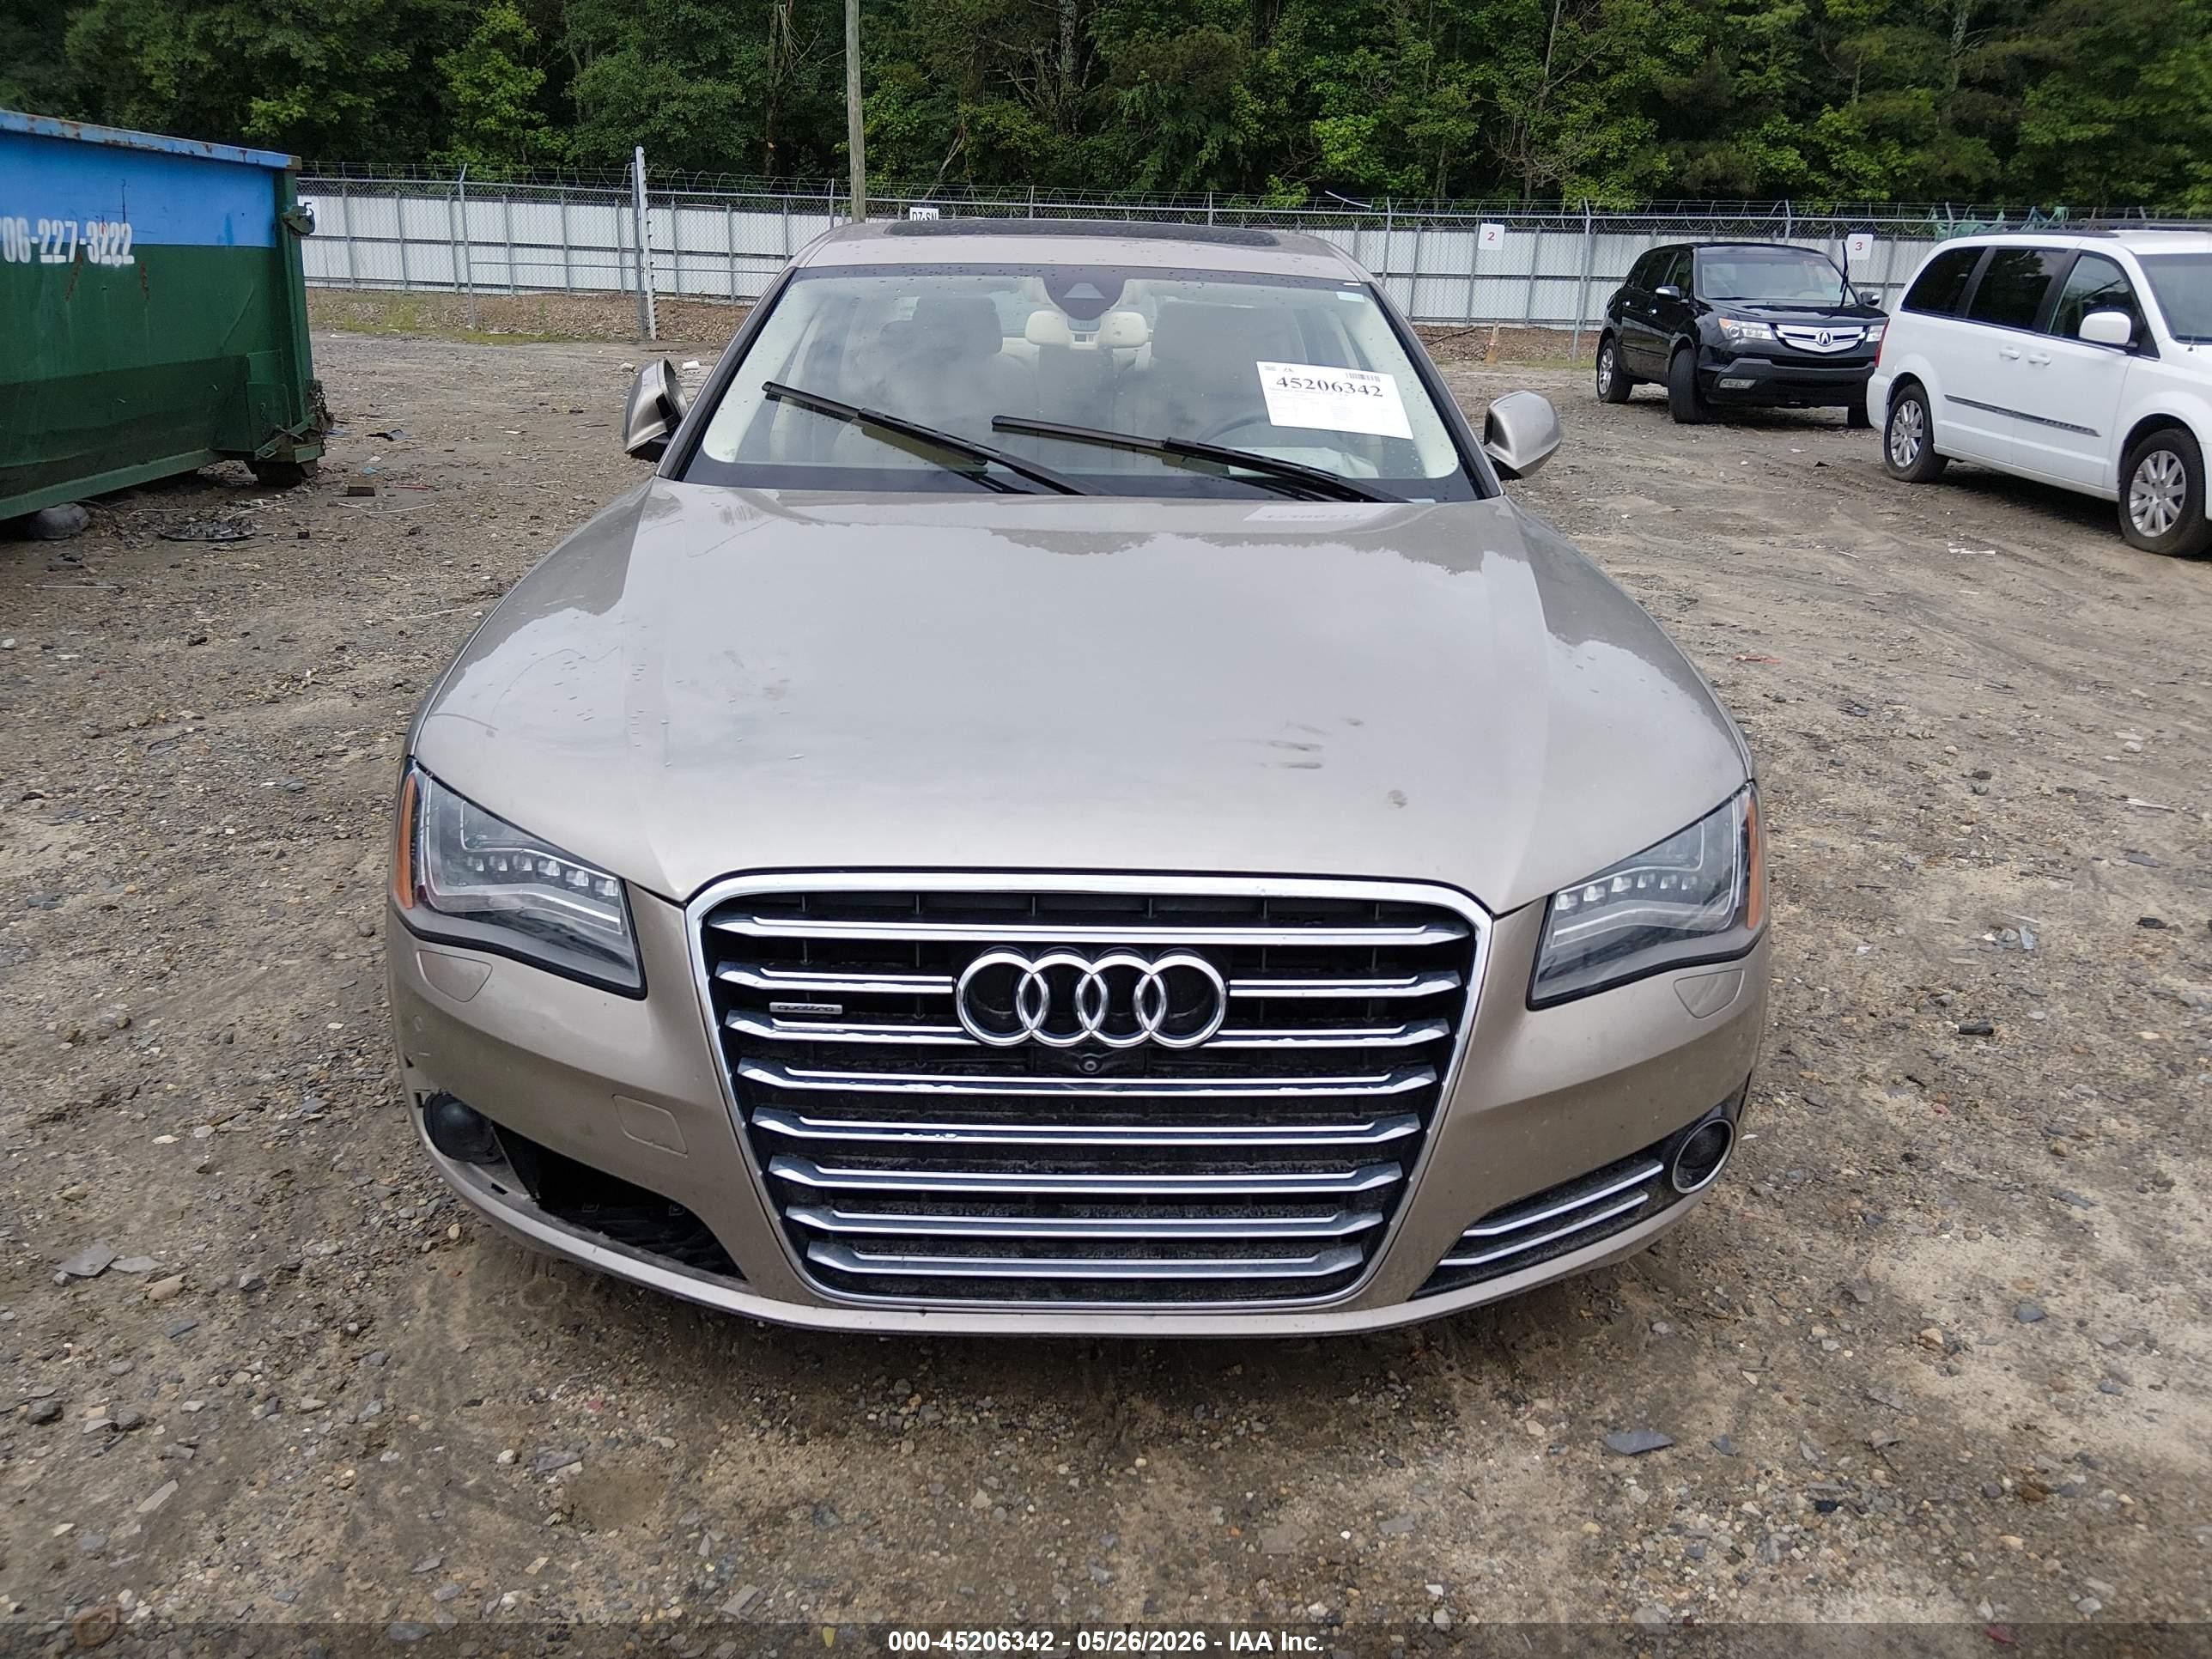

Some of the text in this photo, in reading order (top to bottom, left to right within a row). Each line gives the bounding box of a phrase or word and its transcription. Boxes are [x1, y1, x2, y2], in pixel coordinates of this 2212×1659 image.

[0, 216, 135, 264] 06-227-3222
[1487, 231, 1496, 241] 2
[1855, 241, 1863, 252] 3
[1276, 376, 1383, 398] 45206342
